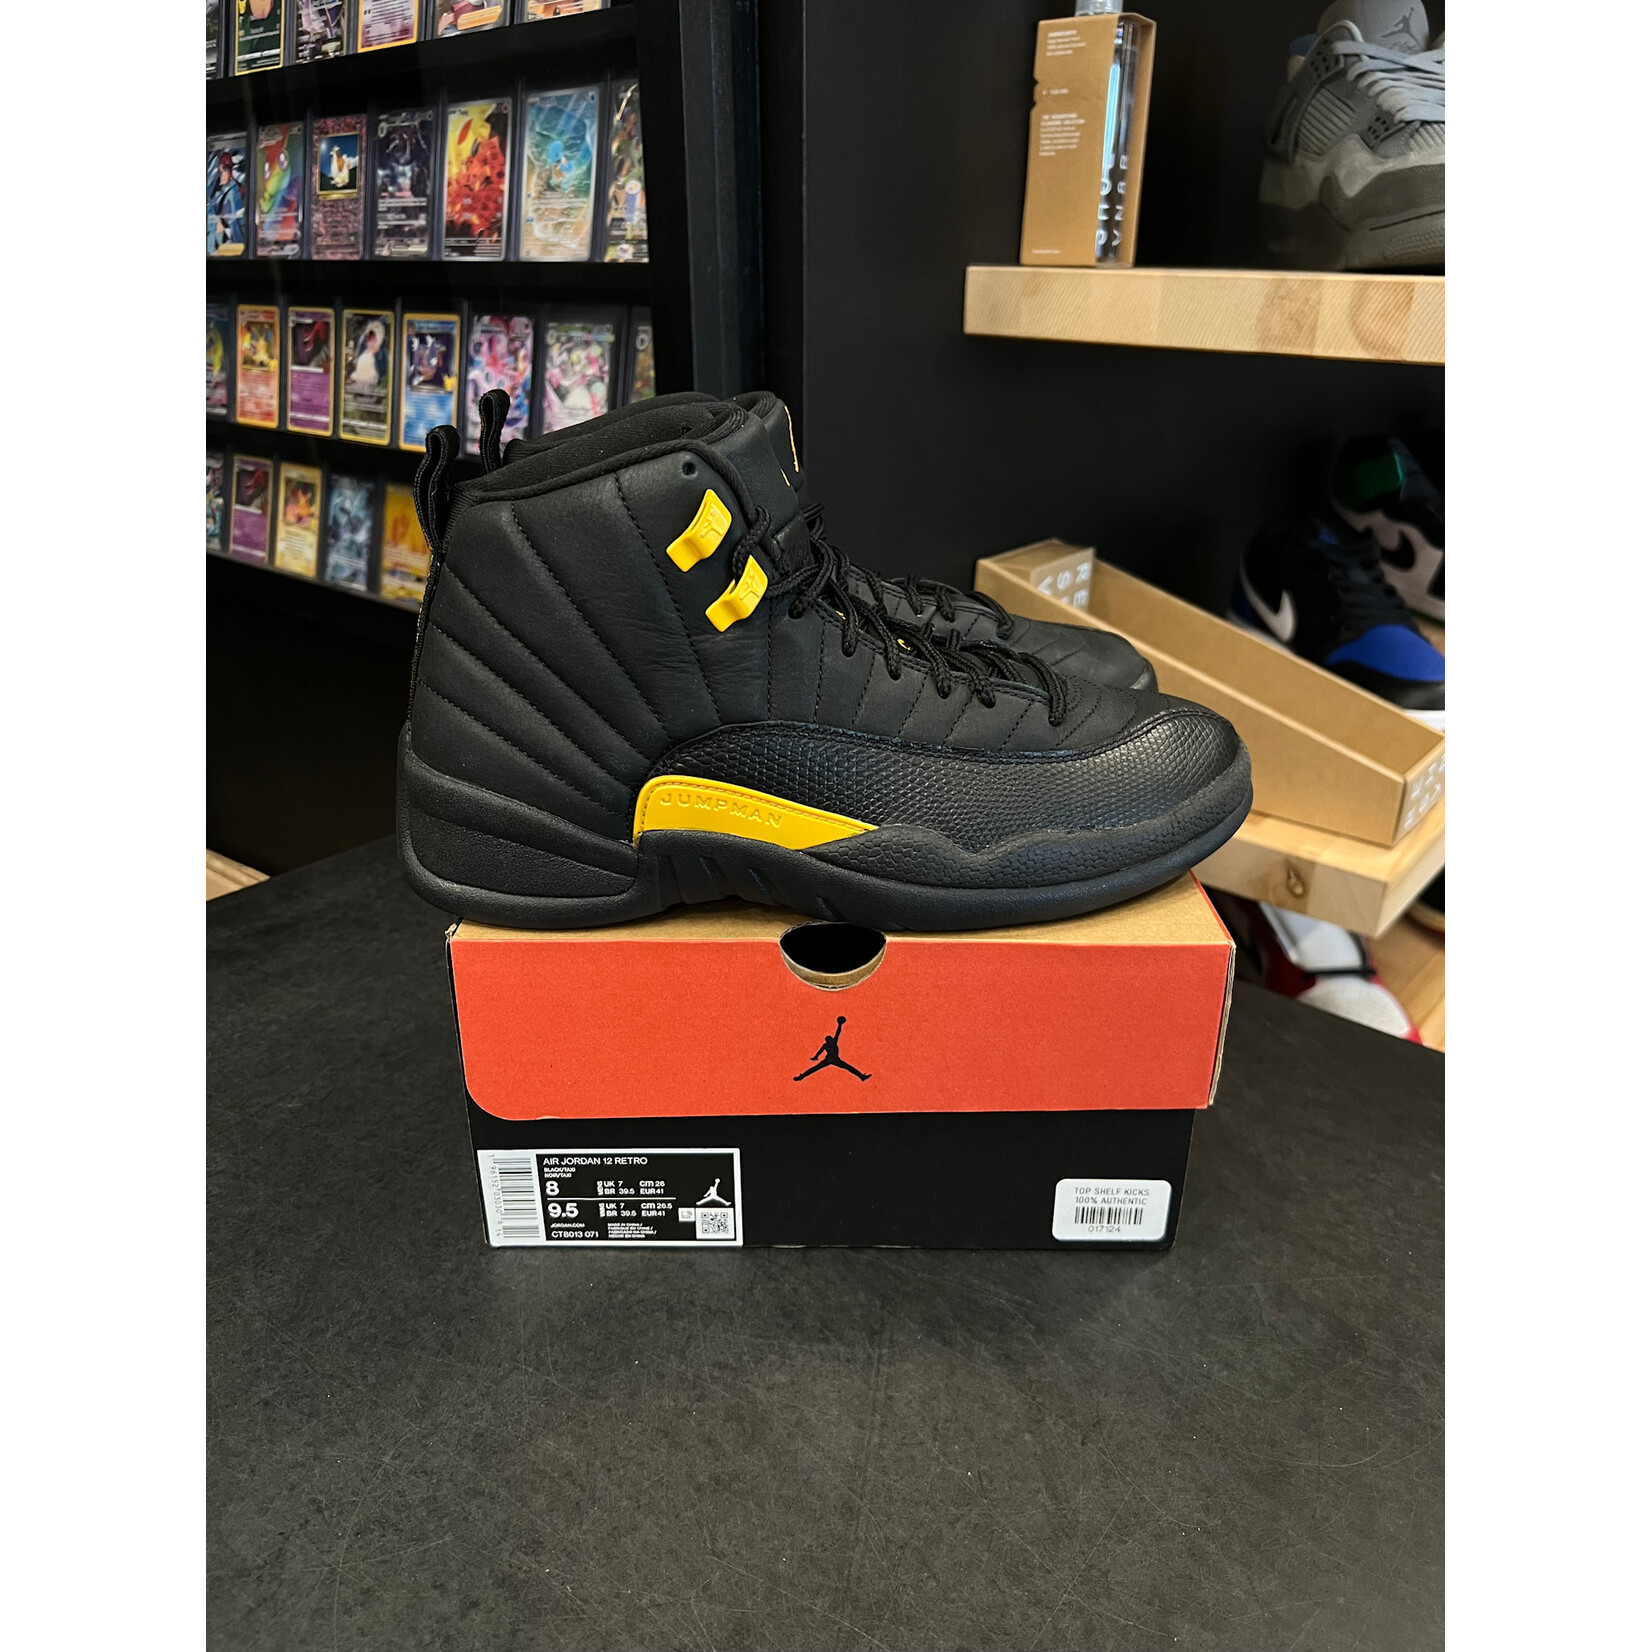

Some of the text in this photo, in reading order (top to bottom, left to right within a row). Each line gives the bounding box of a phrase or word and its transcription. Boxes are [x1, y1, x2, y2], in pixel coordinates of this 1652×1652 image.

[660, 793, 783, 829] JUMPMAN
[543, 1157, 648, 1166] AIR JORDAN 12 RETRO
[545, 1181, 560, 1196] 8
[1074, 1187, 1150, 1196] TOP SHELF KICKS
[1100, 1197, 1147, 1205] AUTHENTIC
[548, 1203, 579, 1218] 9.5
[1088, 1225, 1121, 1233] 017124
[551, 1230, 599, 1238] CT8013 071
